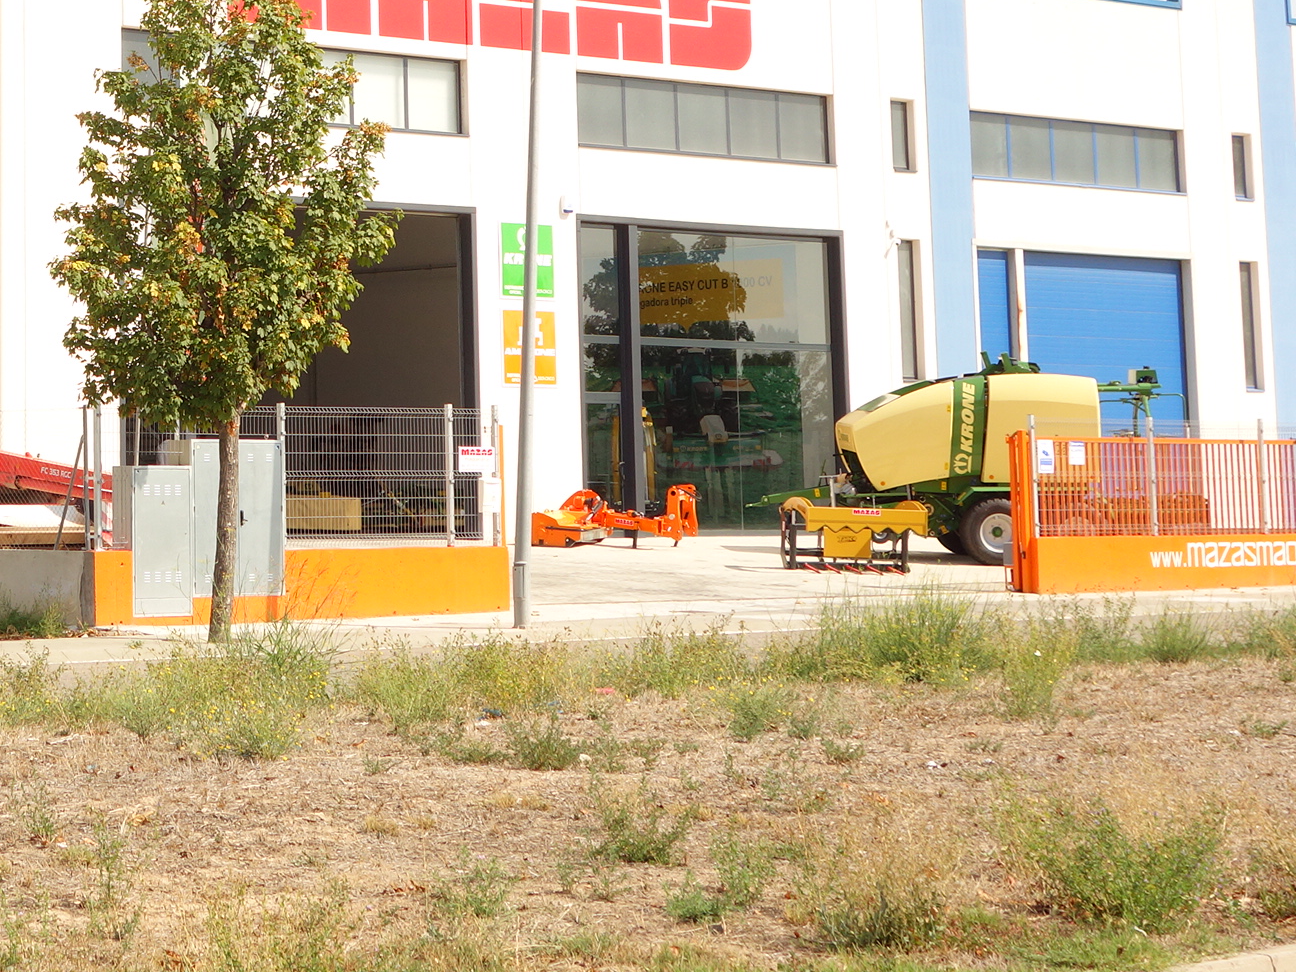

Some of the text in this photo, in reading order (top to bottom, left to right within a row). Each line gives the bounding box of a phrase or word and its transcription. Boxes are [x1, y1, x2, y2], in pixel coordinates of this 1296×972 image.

[504, 252, 553, 267] KRNE
[669, 280, 694, 292] EASY
[697, 279, 718, 290] CUT
[722, 278, 728, 289] B
[640, 298, 669, 310] gadora
[504, 347, 556, 357] AMONE
[960, 382, 976, 454] KRONE
[40, 467, 48, 475] FC
